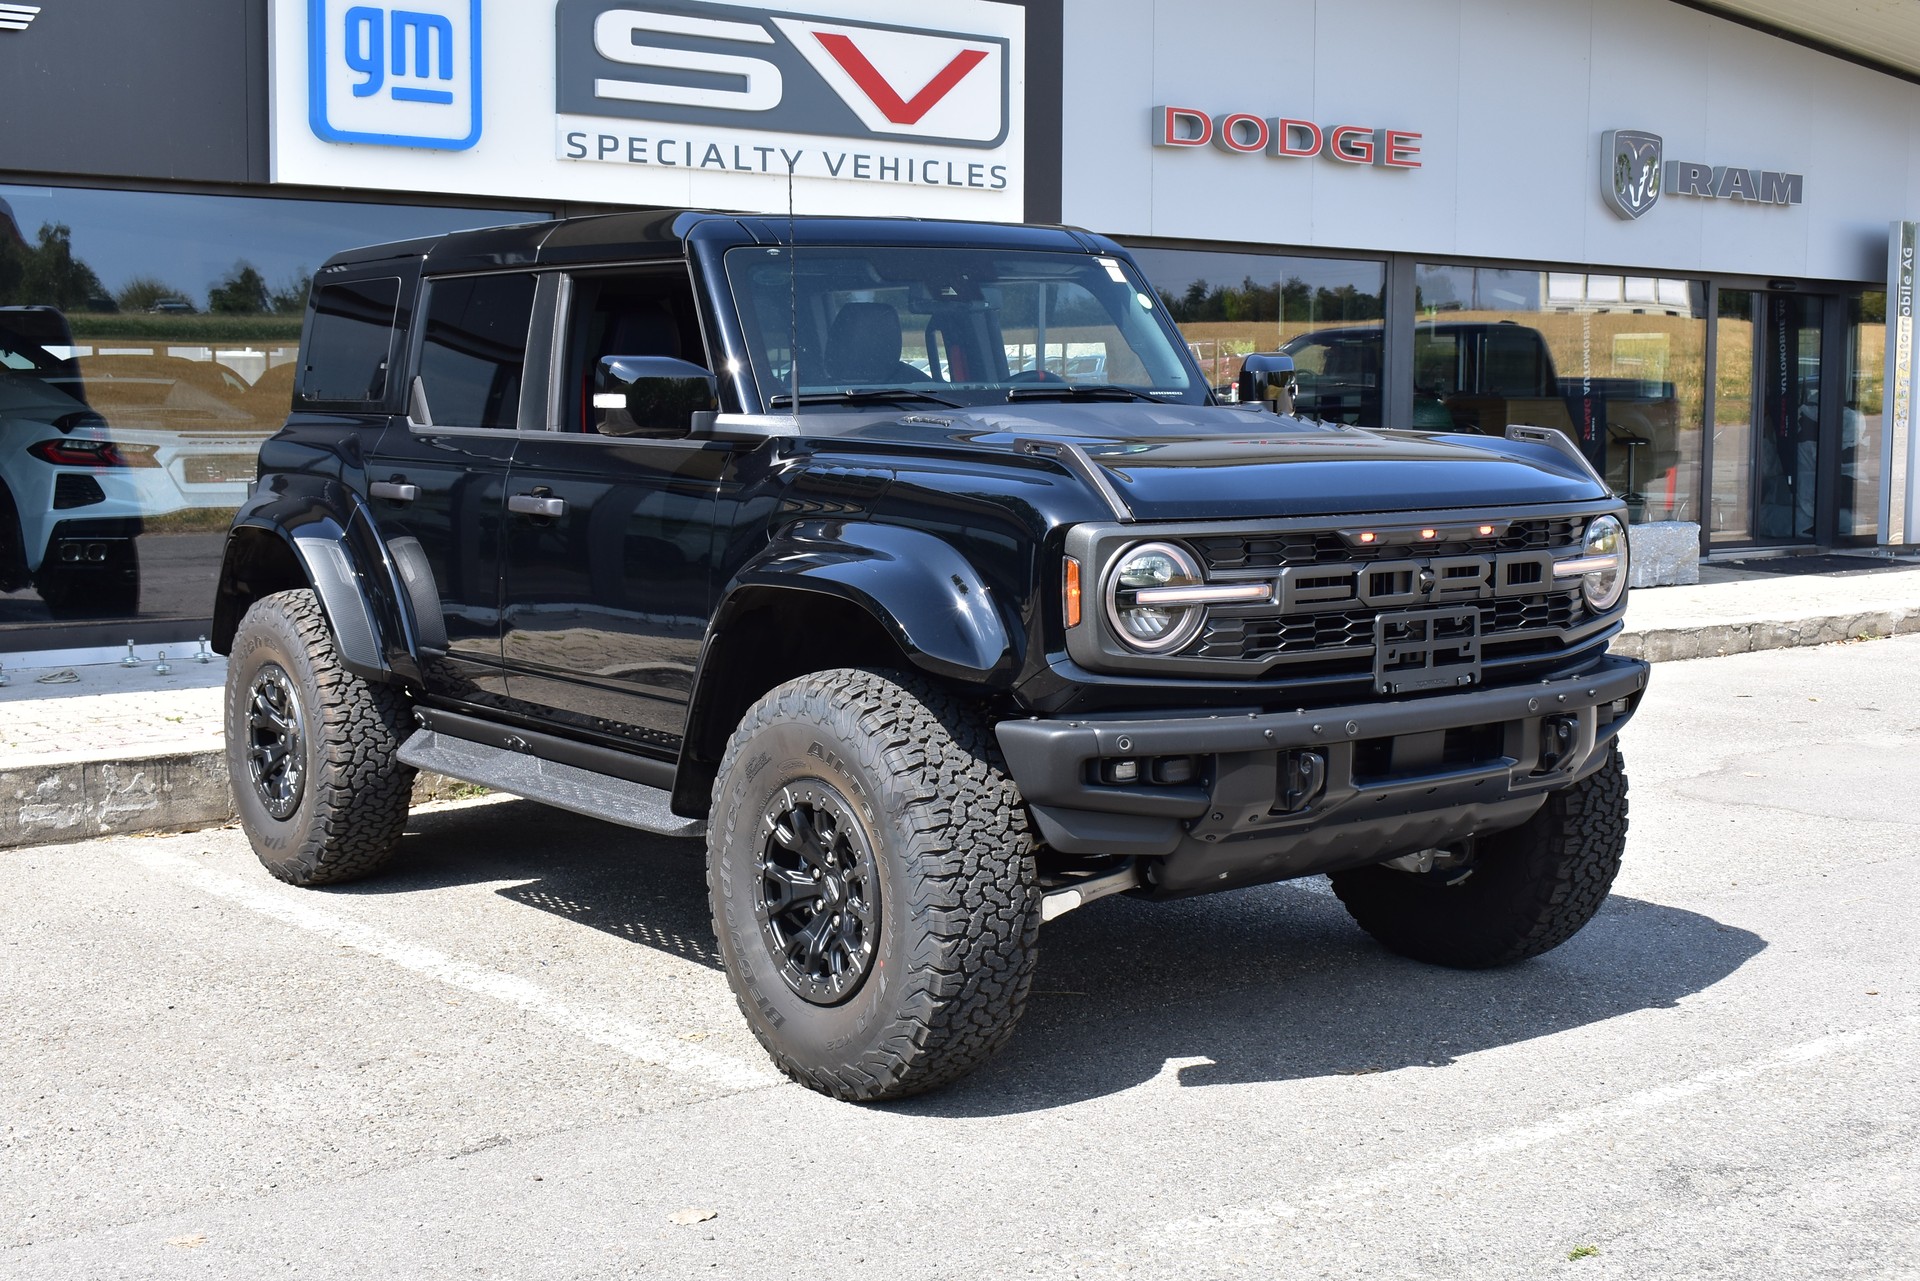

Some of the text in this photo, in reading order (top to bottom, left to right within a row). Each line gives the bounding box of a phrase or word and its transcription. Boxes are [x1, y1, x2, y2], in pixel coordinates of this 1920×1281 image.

[345, 6, 453, 97] gm
[594, 9, 990, 125] SV
[566, 132, 1008, 190] SPECIALTY VEHICLES
[1154, 105, 1422, 169] DODGE
[1668, 160, 1803, 205] RAM
[1903, 247, 1913, 271] AG
[1898, 275, 1912, 371] Automobile
[1281, 552, 1553, 615] FORD
